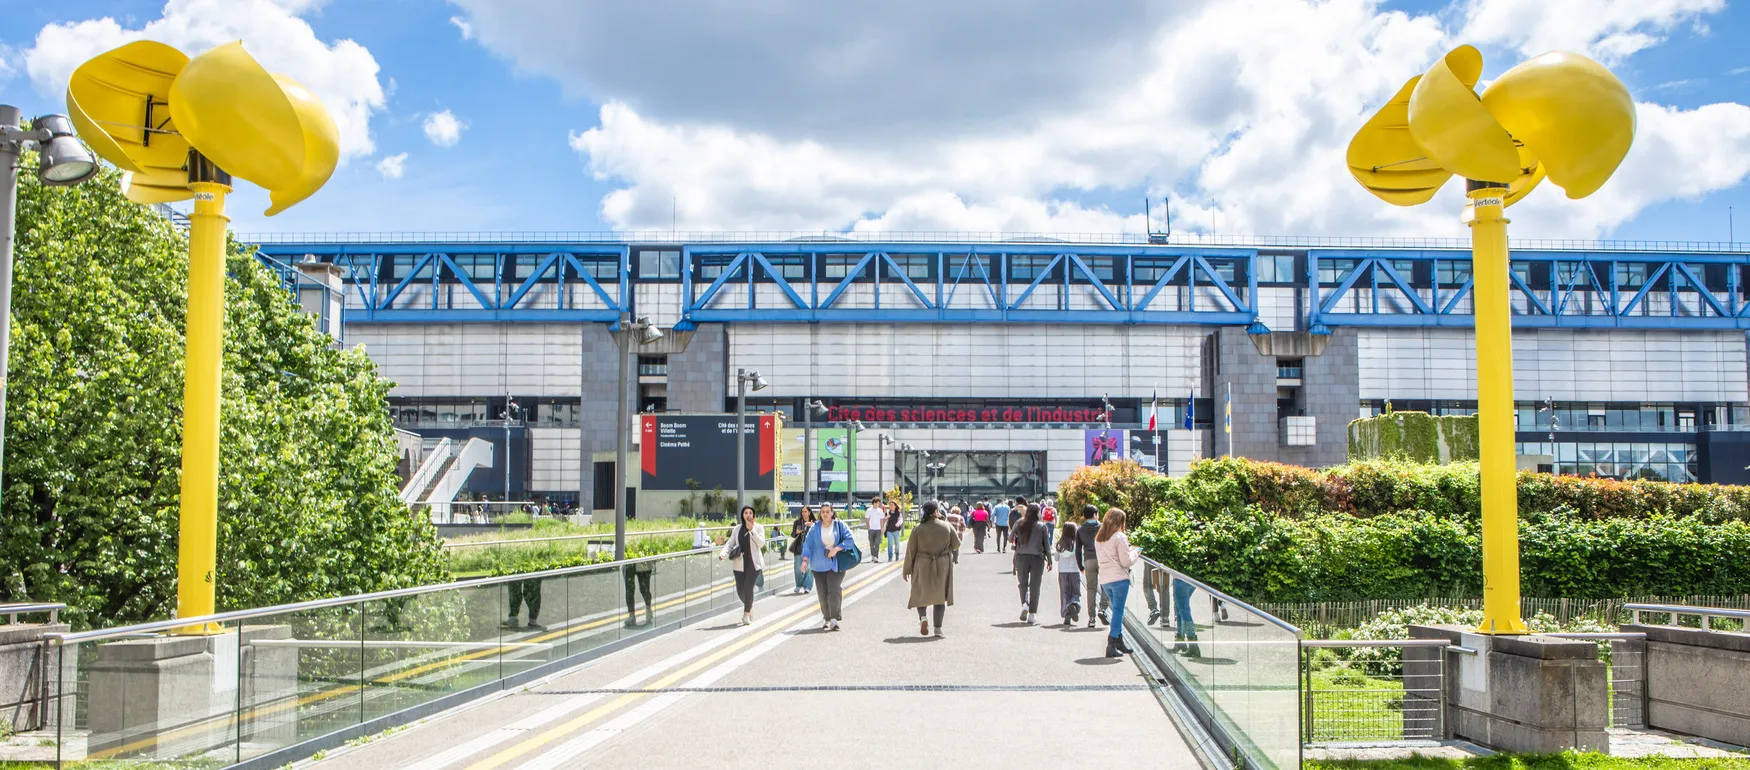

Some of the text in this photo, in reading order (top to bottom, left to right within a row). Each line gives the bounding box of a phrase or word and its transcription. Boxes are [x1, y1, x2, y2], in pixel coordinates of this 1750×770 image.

[828, 404, 861, 421] Cité
[865, 406, 896, 421] des
[901, 405, 977, 422] sciences
[981, 408, 999, 421] et
[1003, 406, 1023, 421] de
[660, 440, 690, 448] Cinéma Pathé
